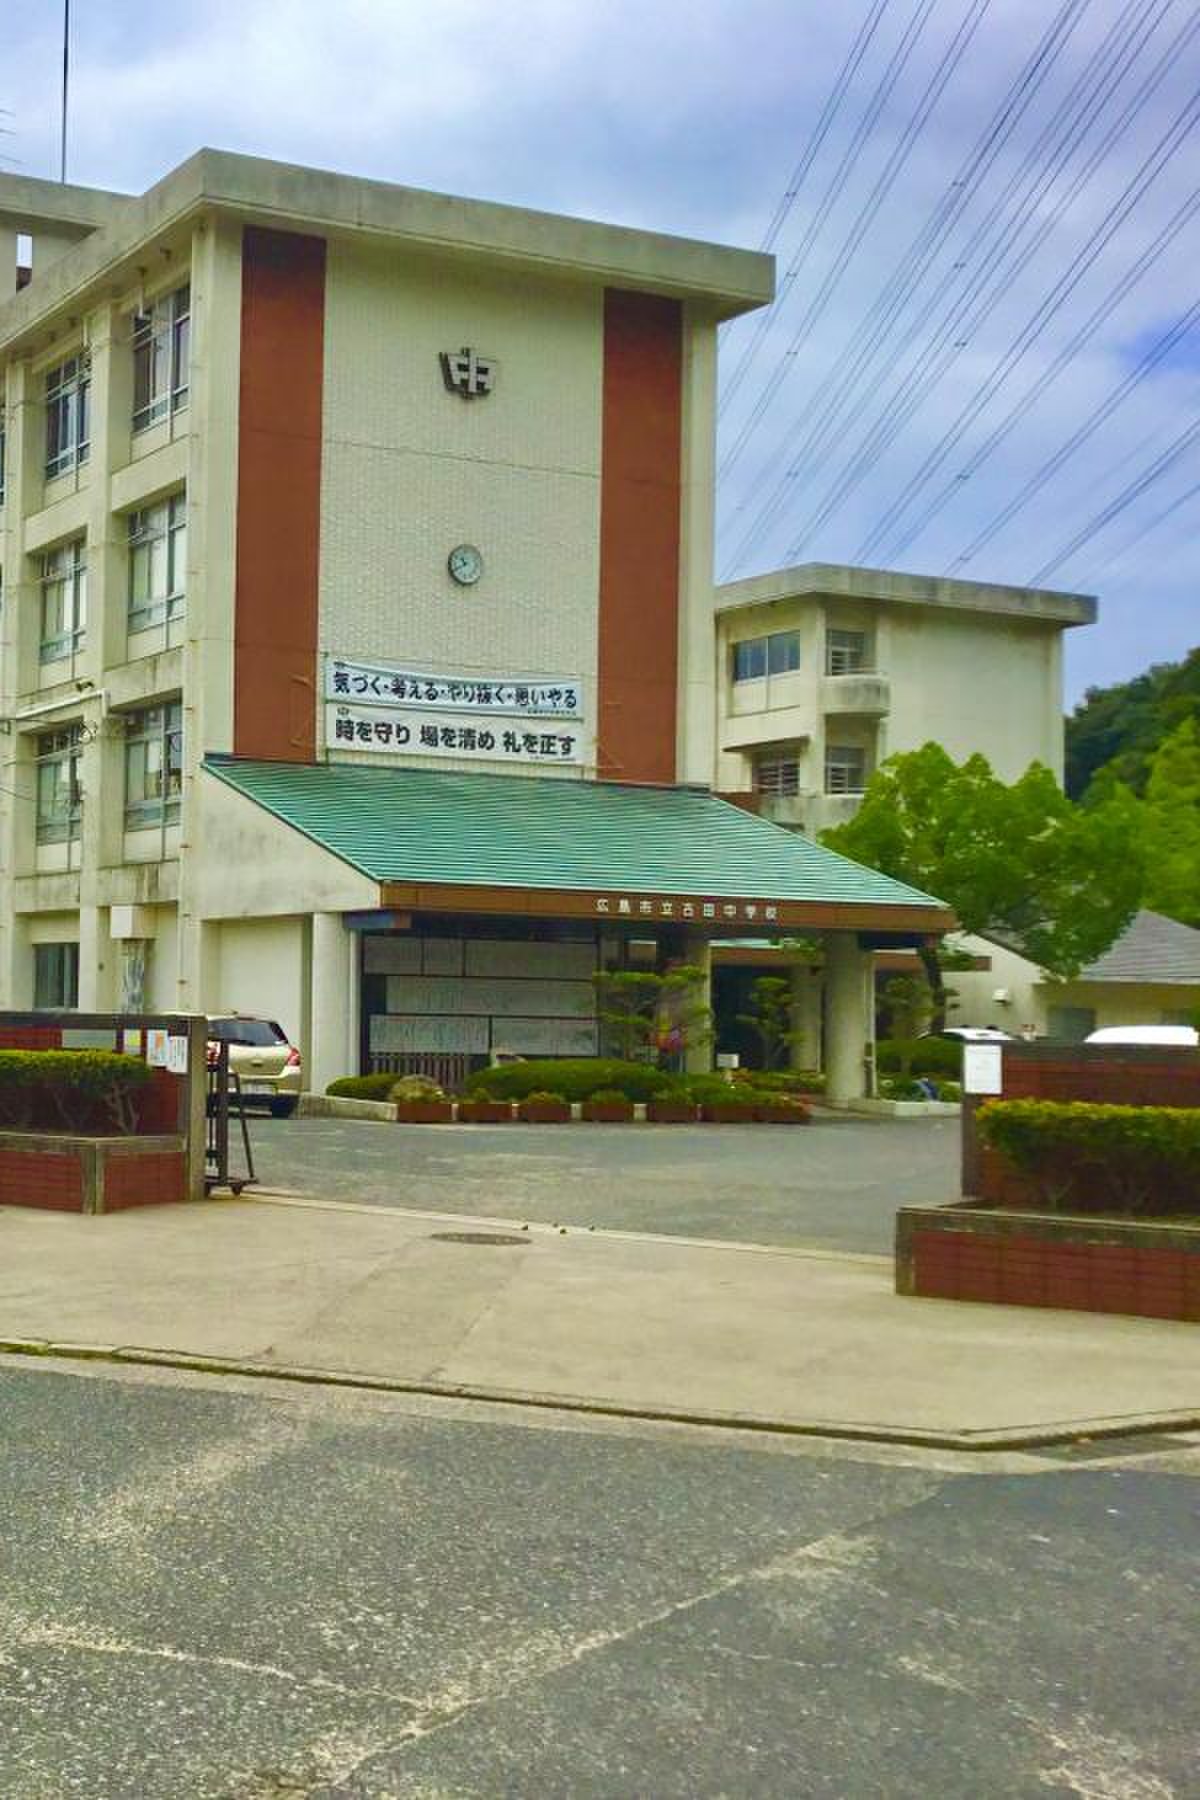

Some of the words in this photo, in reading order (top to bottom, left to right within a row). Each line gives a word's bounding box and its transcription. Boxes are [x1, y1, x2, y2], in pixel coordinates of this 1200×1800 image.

[335, 719, 411, 745] 時を守り
[420, 724, 495, 751] 場を清め
[503, 731, 576, 756] 礼を正す
[596, 899, 777, 920] 広島市立古田中学校
